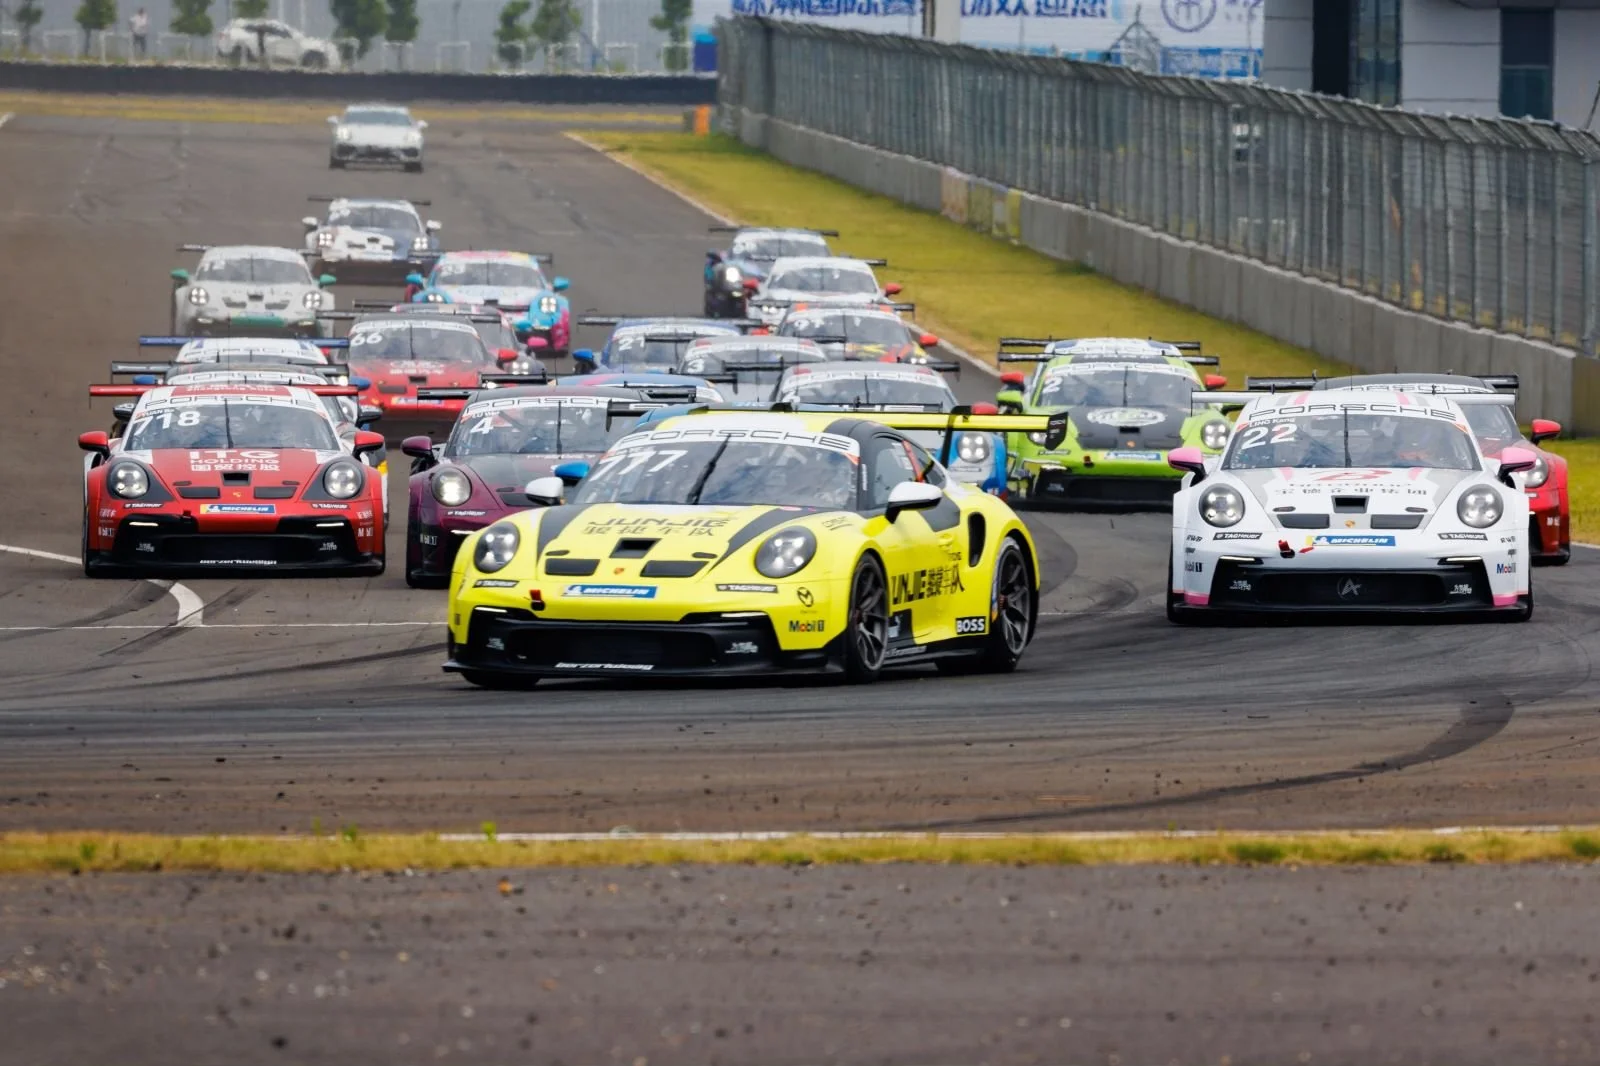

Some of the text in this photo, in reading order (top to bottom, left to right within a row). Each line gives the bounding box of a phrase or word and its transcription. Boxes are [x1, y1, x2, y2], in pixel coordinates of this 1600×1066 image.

[350, 332, 383, 346] 66
[1248, 403, 1457, 422] PORSCHE
[134, 409, 201, 436] 718
[470, 416, 494, 435] 4
[619, 429, 851, 451] PORSCHE
[1241, 423, 1298, 450] 22
[189, 450, 279, 459] ITG
[588, 449, 689, 483] 777
[588, 518, 730, 528] JUNJIE
[583, 587, 650, 595] MICHELIN
[788, 619, 815, 633] Mobil
[956, 618, 986, 633] BOSS
